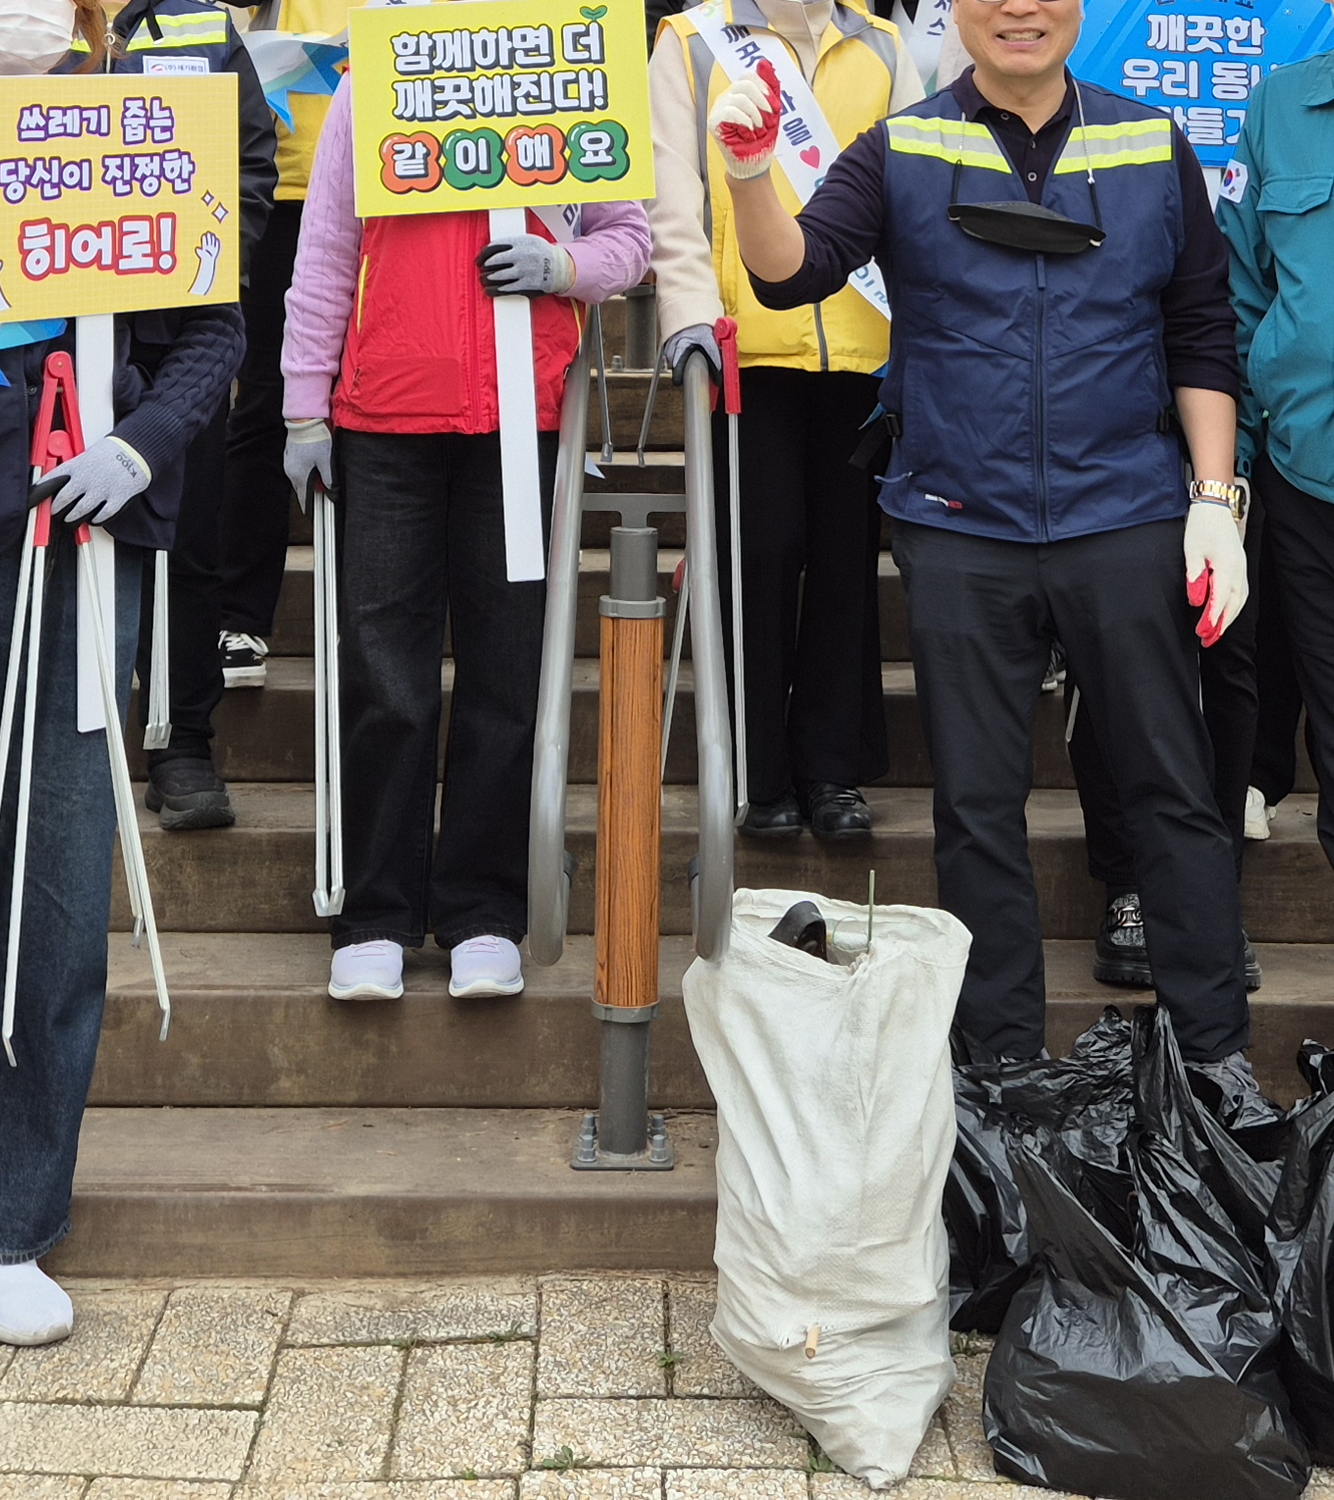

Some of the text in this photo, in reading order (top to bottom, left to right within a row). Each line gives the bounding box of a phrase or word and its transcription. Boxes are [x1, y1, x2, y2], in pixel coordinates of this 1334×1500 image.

[390, 21, 605, 74] 함께하면 더
[1146, 14, 1267, 56] 깨끗한
[391, 68, 609, 121] 깨끗해진다!
[1122, 58, 1200, 99] 우리
[18, 96, 175, 145] 쓰레기 줍는
[102, 148, 196, 196] 진정한
[19, 212, 177, 281] 히어로!
